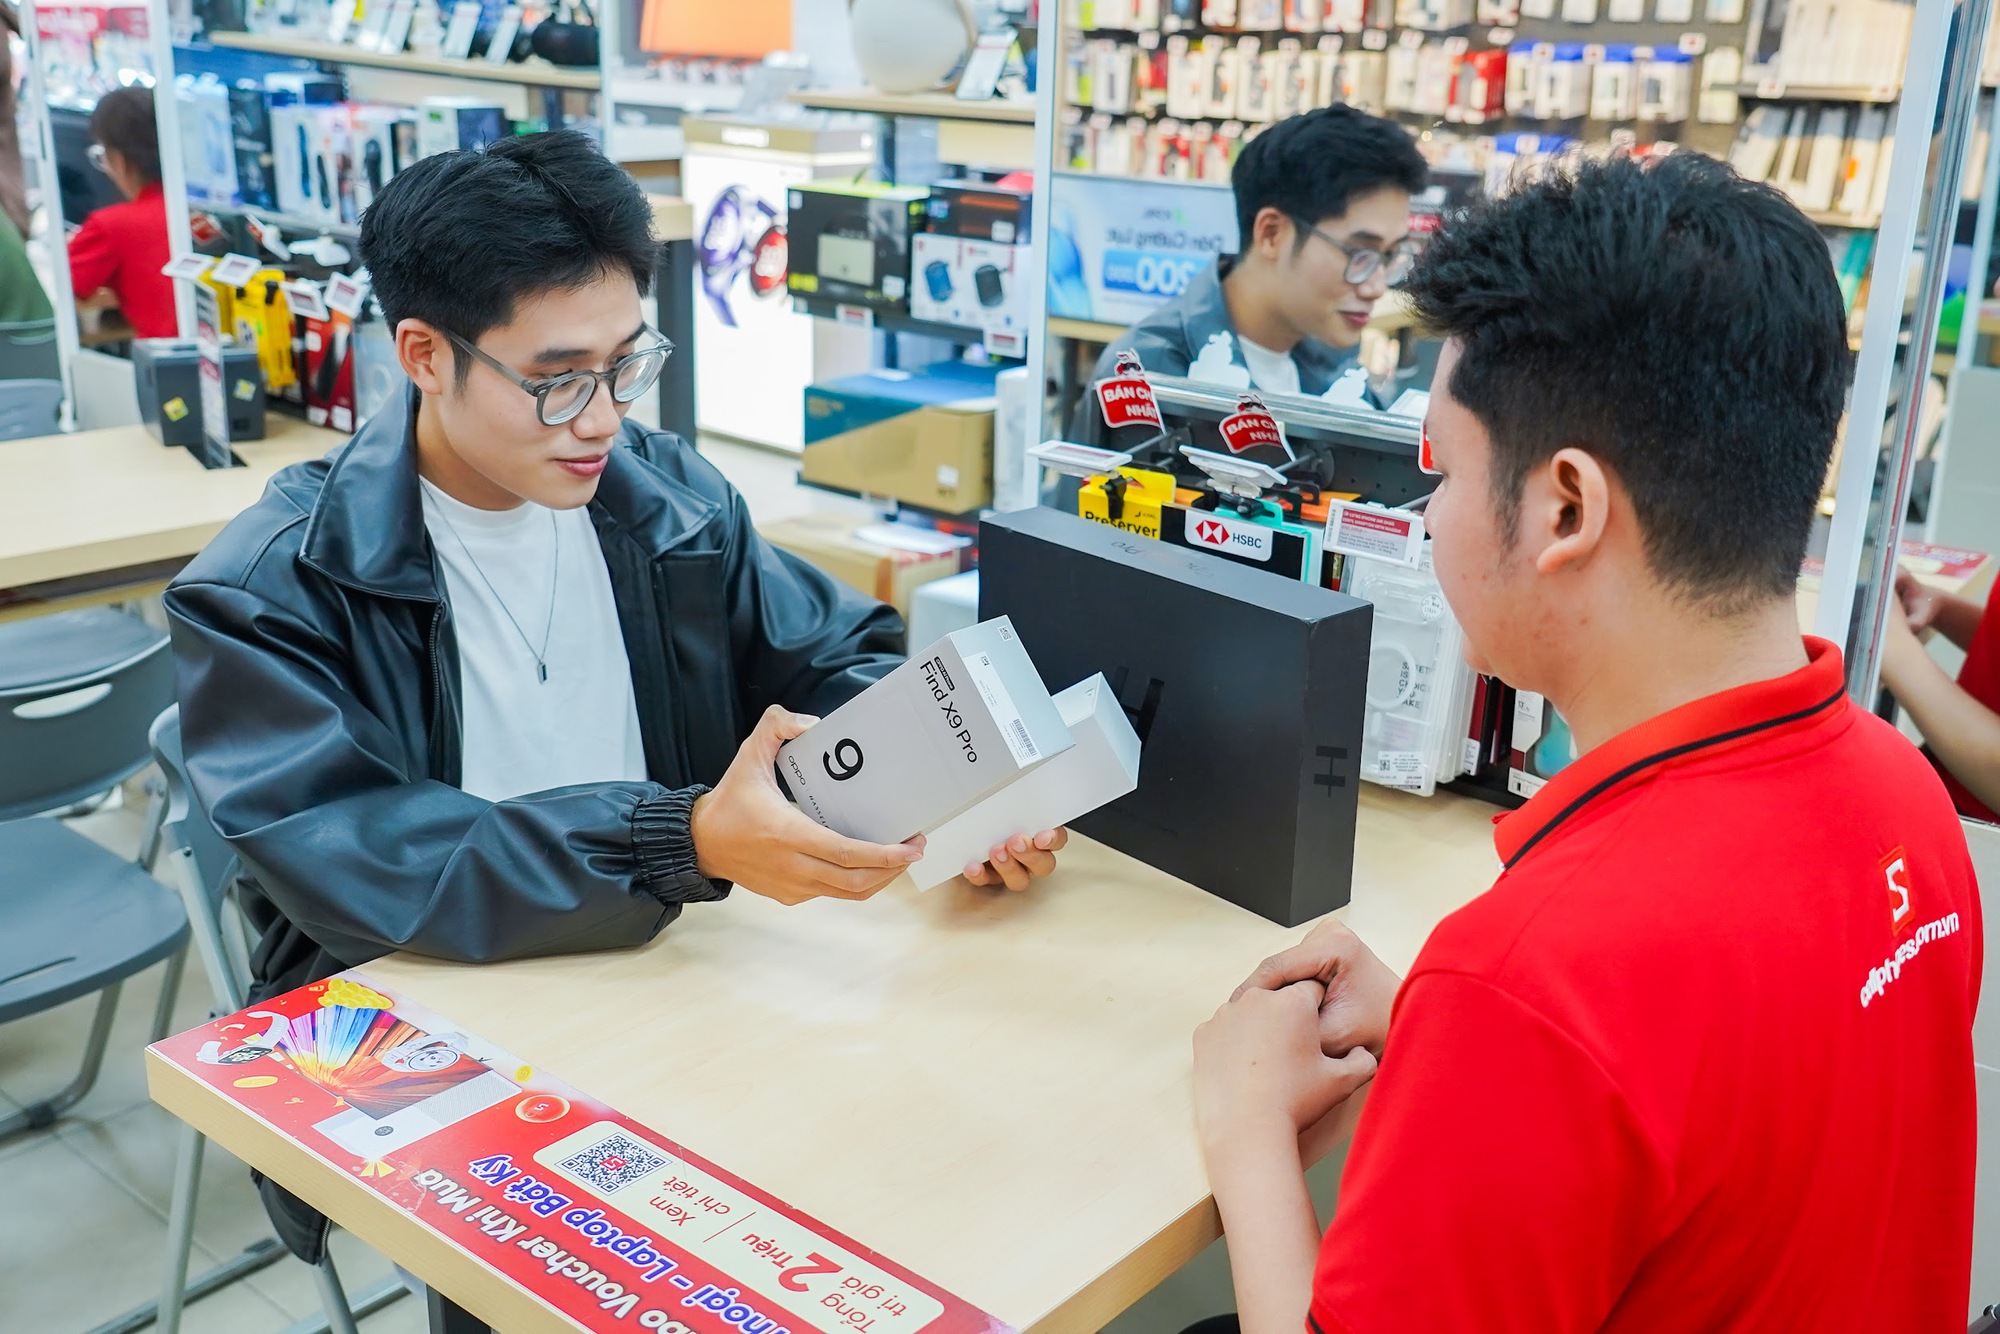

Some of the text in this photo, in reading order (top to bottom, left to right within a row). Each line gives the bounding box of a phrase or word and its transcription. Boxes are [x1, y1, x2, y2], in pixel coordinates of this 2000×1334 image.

[1103, 384, 1153, 403] BÁN CH
[1226, 418, 1260, 436] BÁN
[1249, 430, 1281, 443] NHẤ
[1232, 532, 1262, 549] HSBC
[920, 660, 977, 763] Find X9 Pro
[823, 738, 864, 781] 9
[468, 1154, 523, 1187] Kỳ
[414, 1169, 482, 1214] Mua
[503, 1175, 573, 1218] Bất
[649, 1195, 697, 1227] Xem
[663, 1175, 731, 1216] chi tiết
[465, 1205, 527, 1243] Khi
[562, 1208, 678, 1283] Laptop
[741, 1233, 844, 1293] 2 Triệu
[517, 1236, 640, 1318] Voucher
[840, 1276, 907, 1317] trị giá
[820, 1293, 876, 1334] Tổng
